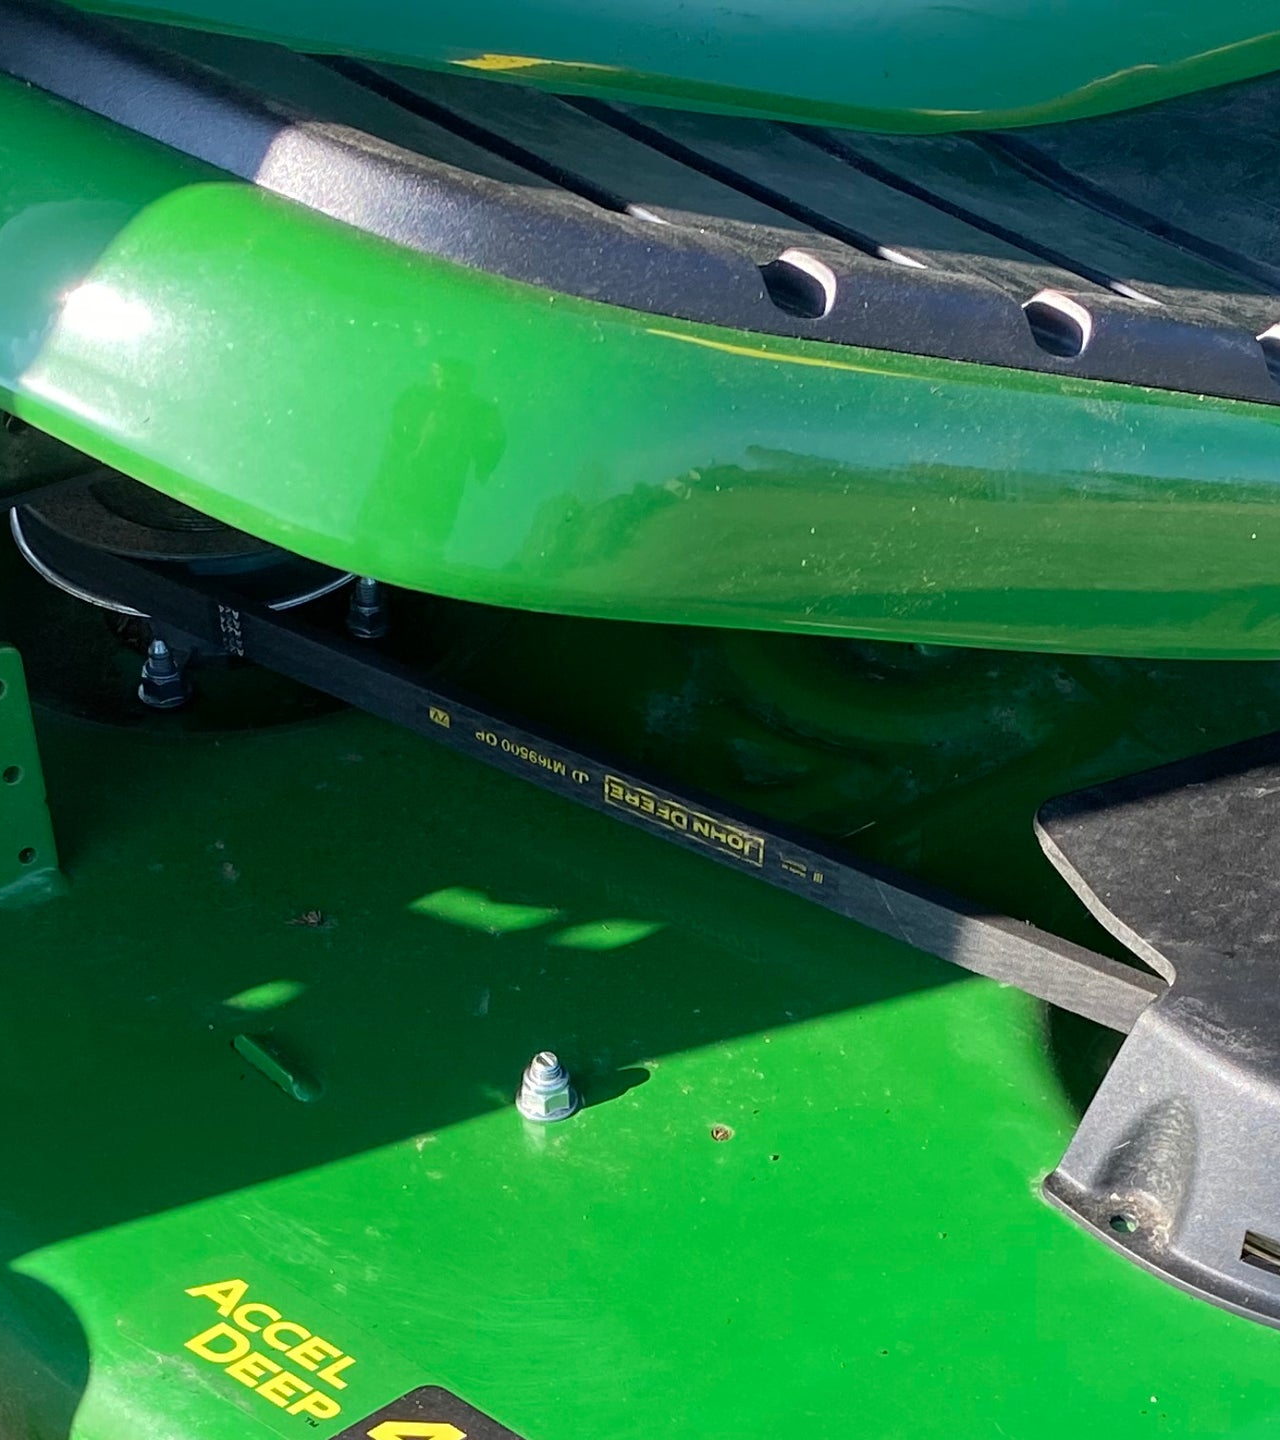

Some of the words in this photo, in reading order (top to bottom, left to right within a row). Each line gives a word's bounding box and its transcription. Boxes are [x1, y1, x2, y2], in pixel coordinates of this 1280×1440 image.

[692, 815, 757, 858] JOHN
[183, 1322, 342, 1419] DEEP
[184, 1278, 357, 1390] ACCEL
